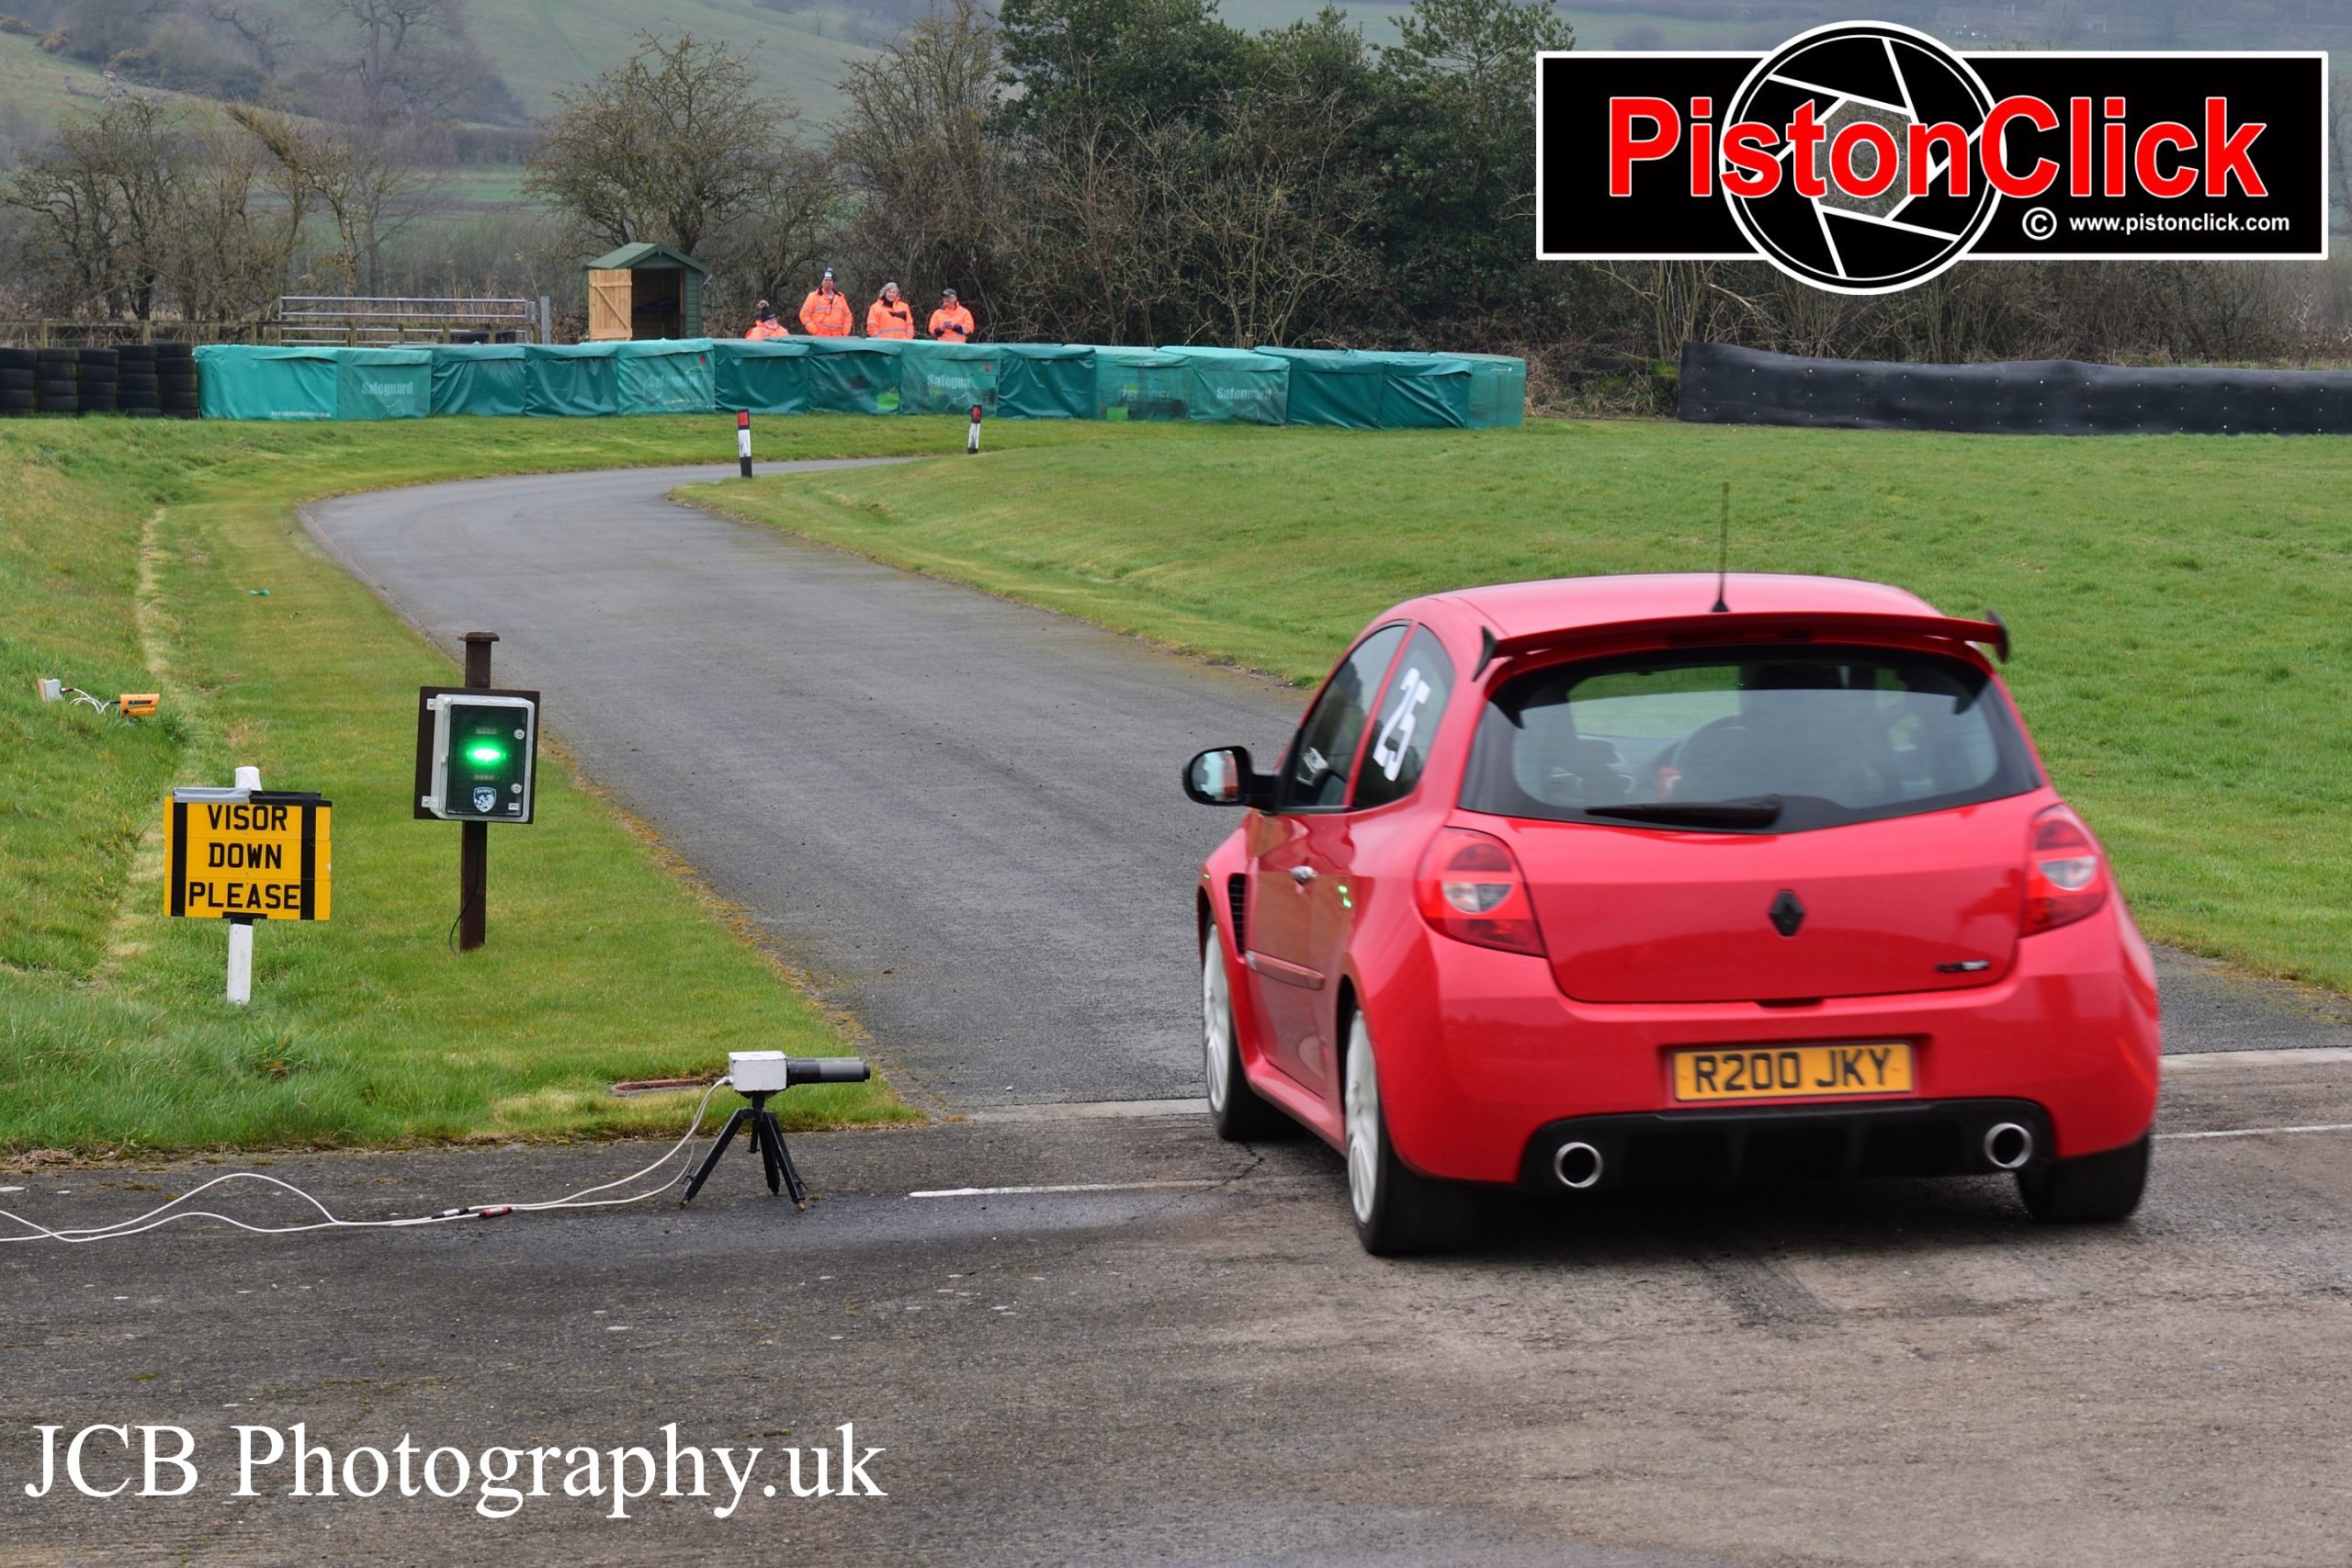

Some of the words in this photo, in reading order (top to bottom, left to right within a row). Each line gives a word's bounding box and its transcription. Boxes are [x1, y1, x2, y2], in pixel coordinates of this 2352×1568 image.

[361, 381, 413, 396] Safeguard
[927, 373, 977, 389] Safegua
[1373, 667, 1431, 782] 25
[208, 805, 288, 831] VISOR
[209, 842, 282, 869] DOWN
[188, 882, 300, 909] PLEASE
[1695, 1051, 1801, 1092] R200
[1815, 1047, 1893, 1088] JKY
